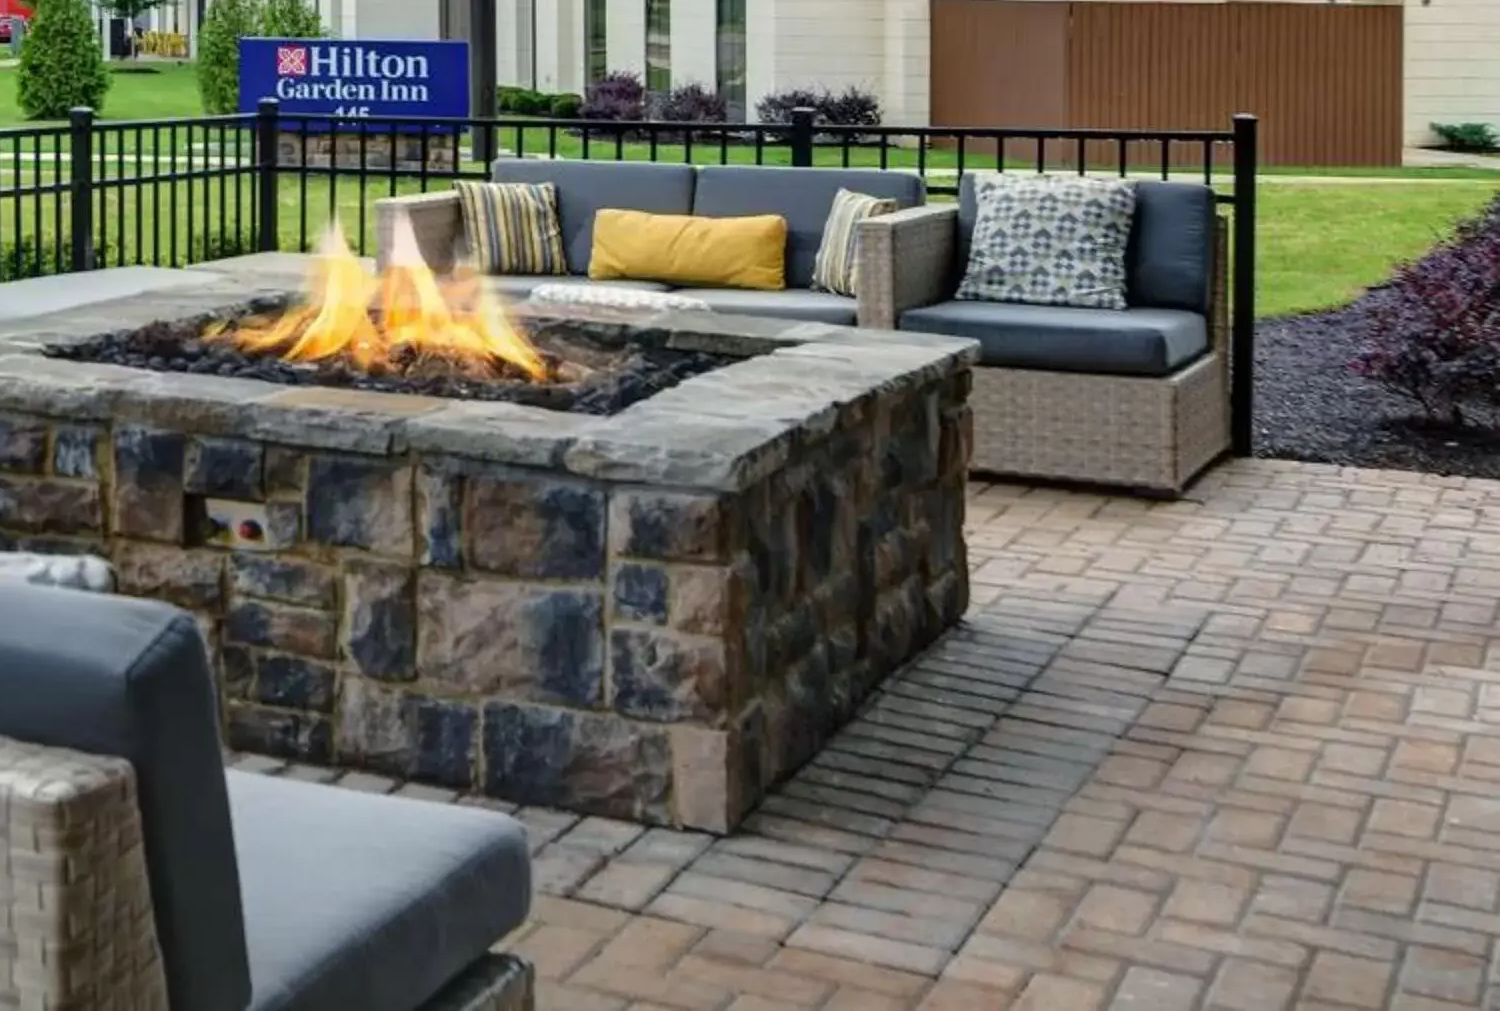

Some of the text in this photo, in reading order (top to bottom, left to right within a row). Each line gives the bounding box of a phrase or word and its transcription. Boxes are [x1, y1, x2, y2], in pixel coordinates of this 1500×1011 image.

[310, 46, 429, 78] Hilton
[276, 77, 429, 102] Garden Inn
